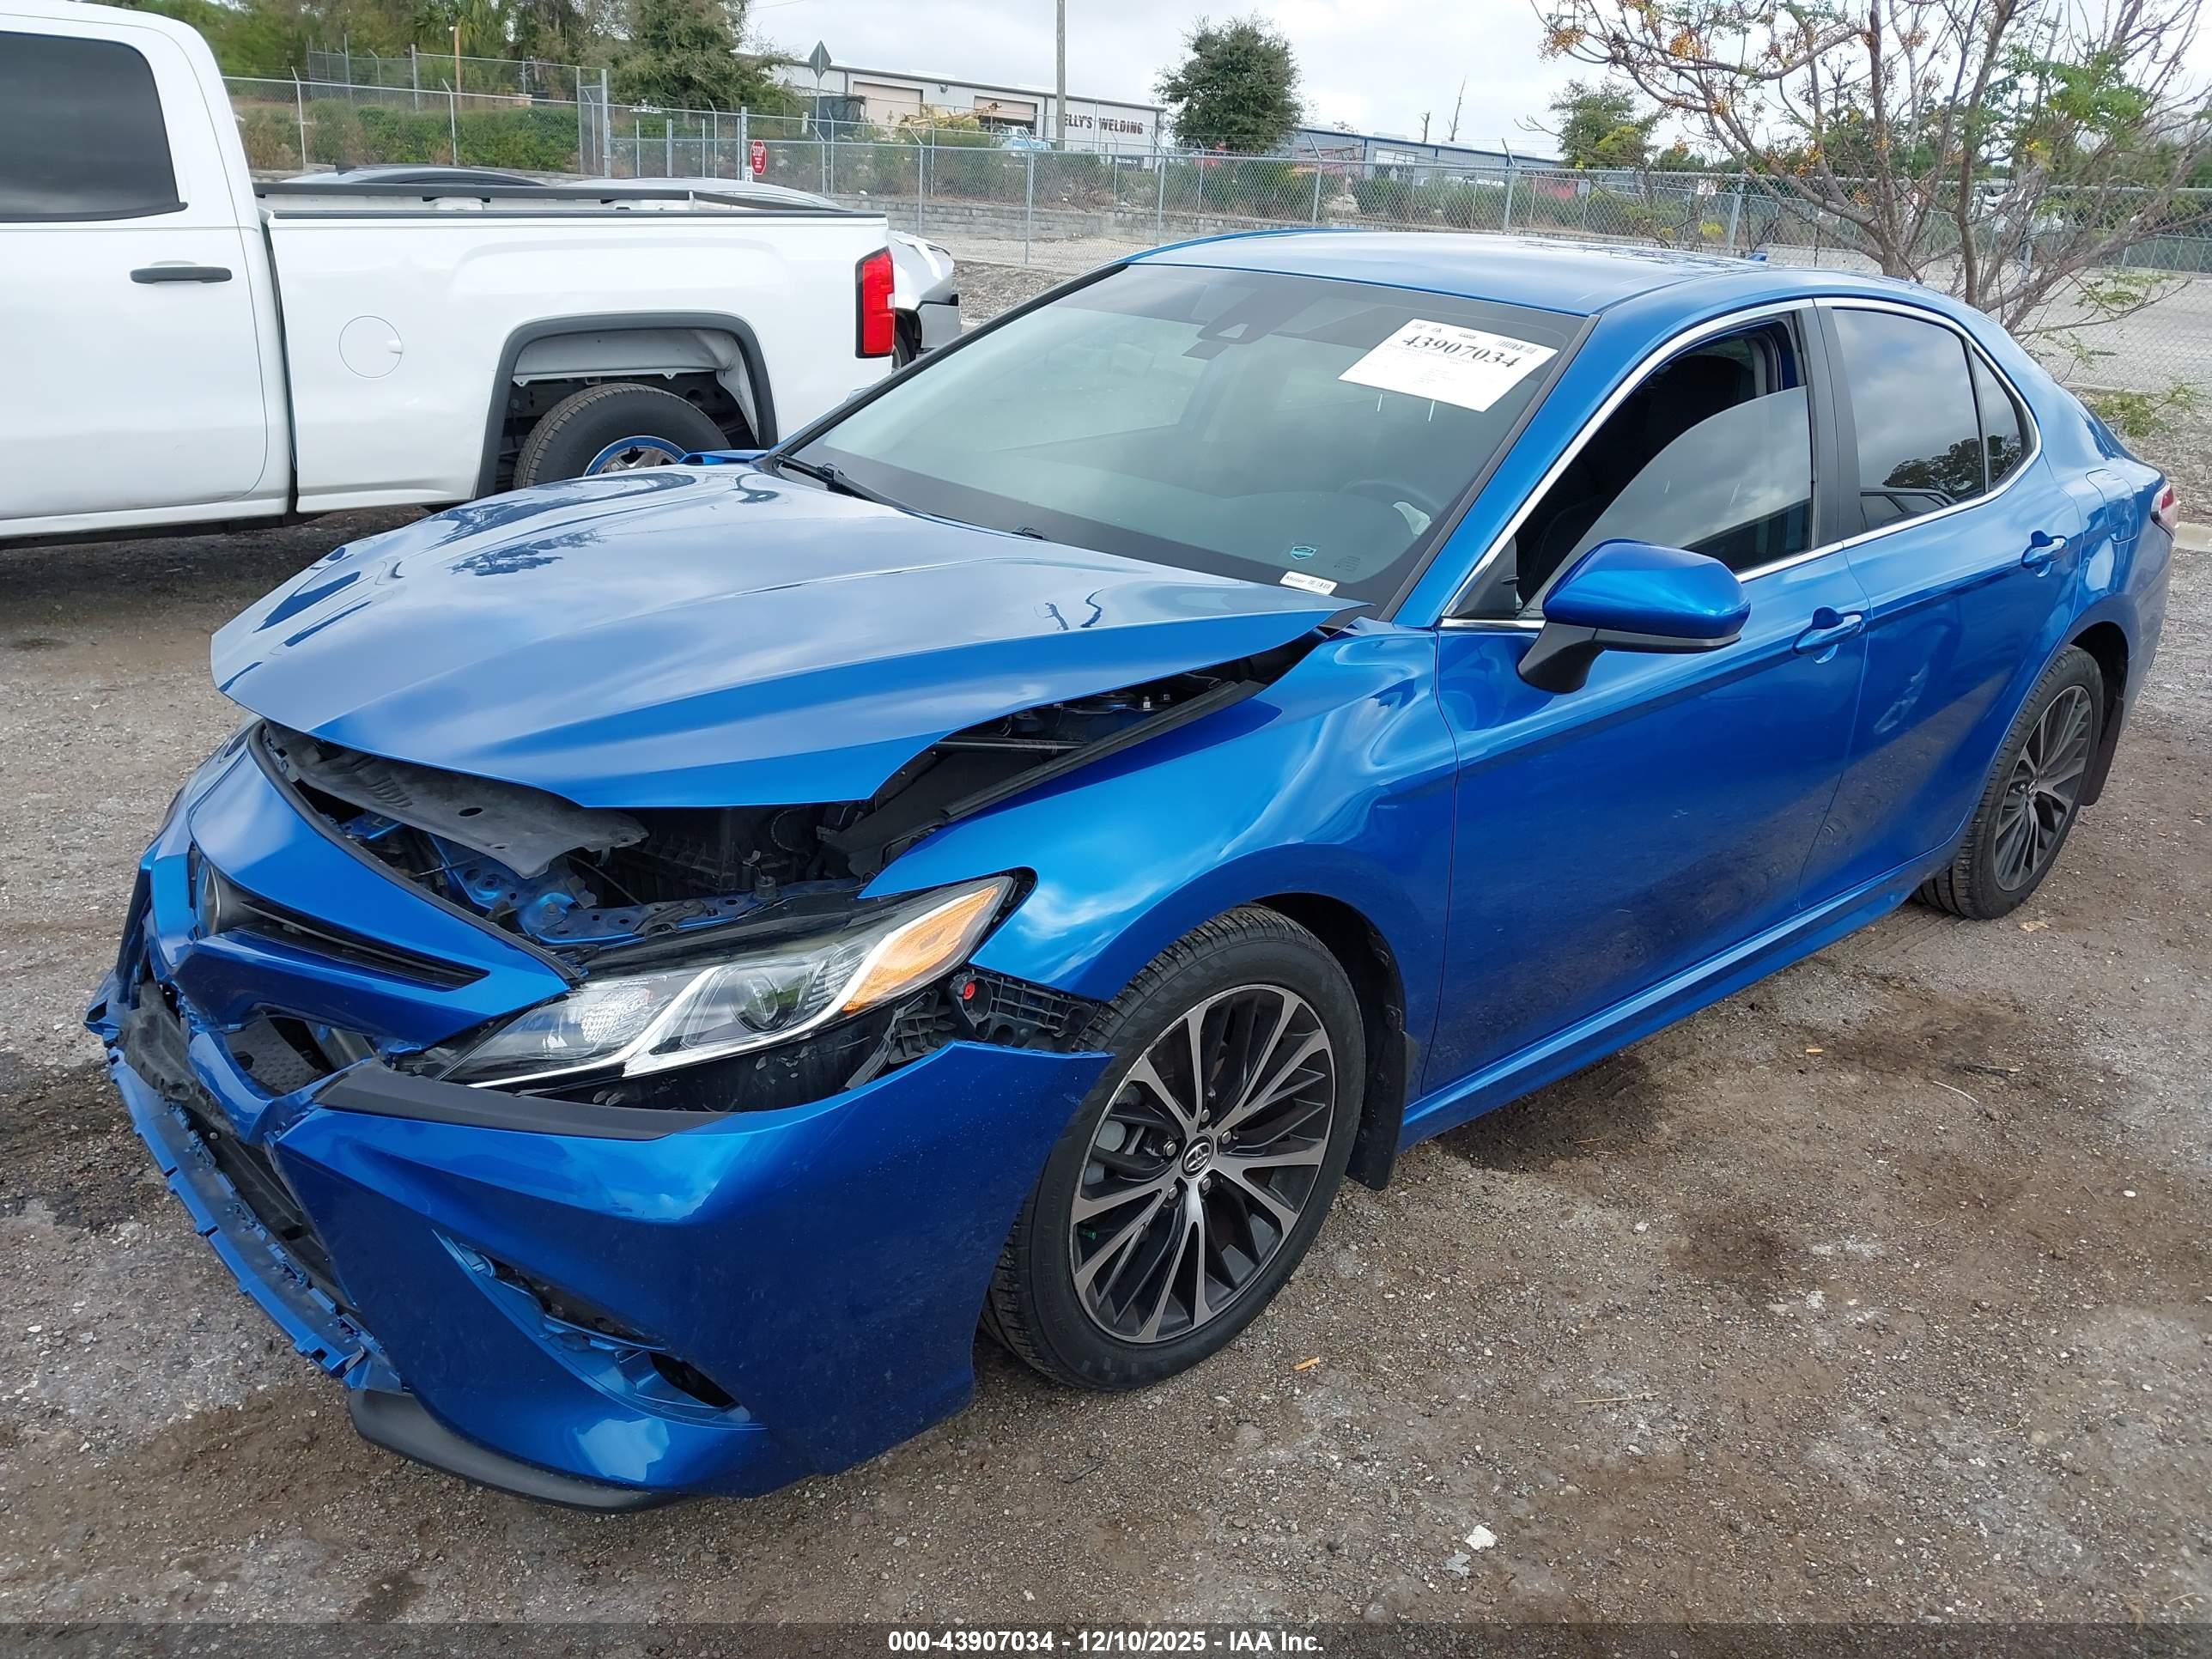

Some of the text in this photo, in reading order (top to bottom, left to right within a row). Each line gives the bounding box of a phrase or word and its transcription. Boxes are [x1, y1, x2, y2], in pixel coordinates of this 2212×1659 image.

[1065, 113, 1144, 135] ELLY'S WELDING
[752, 146, 764, 156] STOP
[1401, 334, 1522, 368] 43907034
